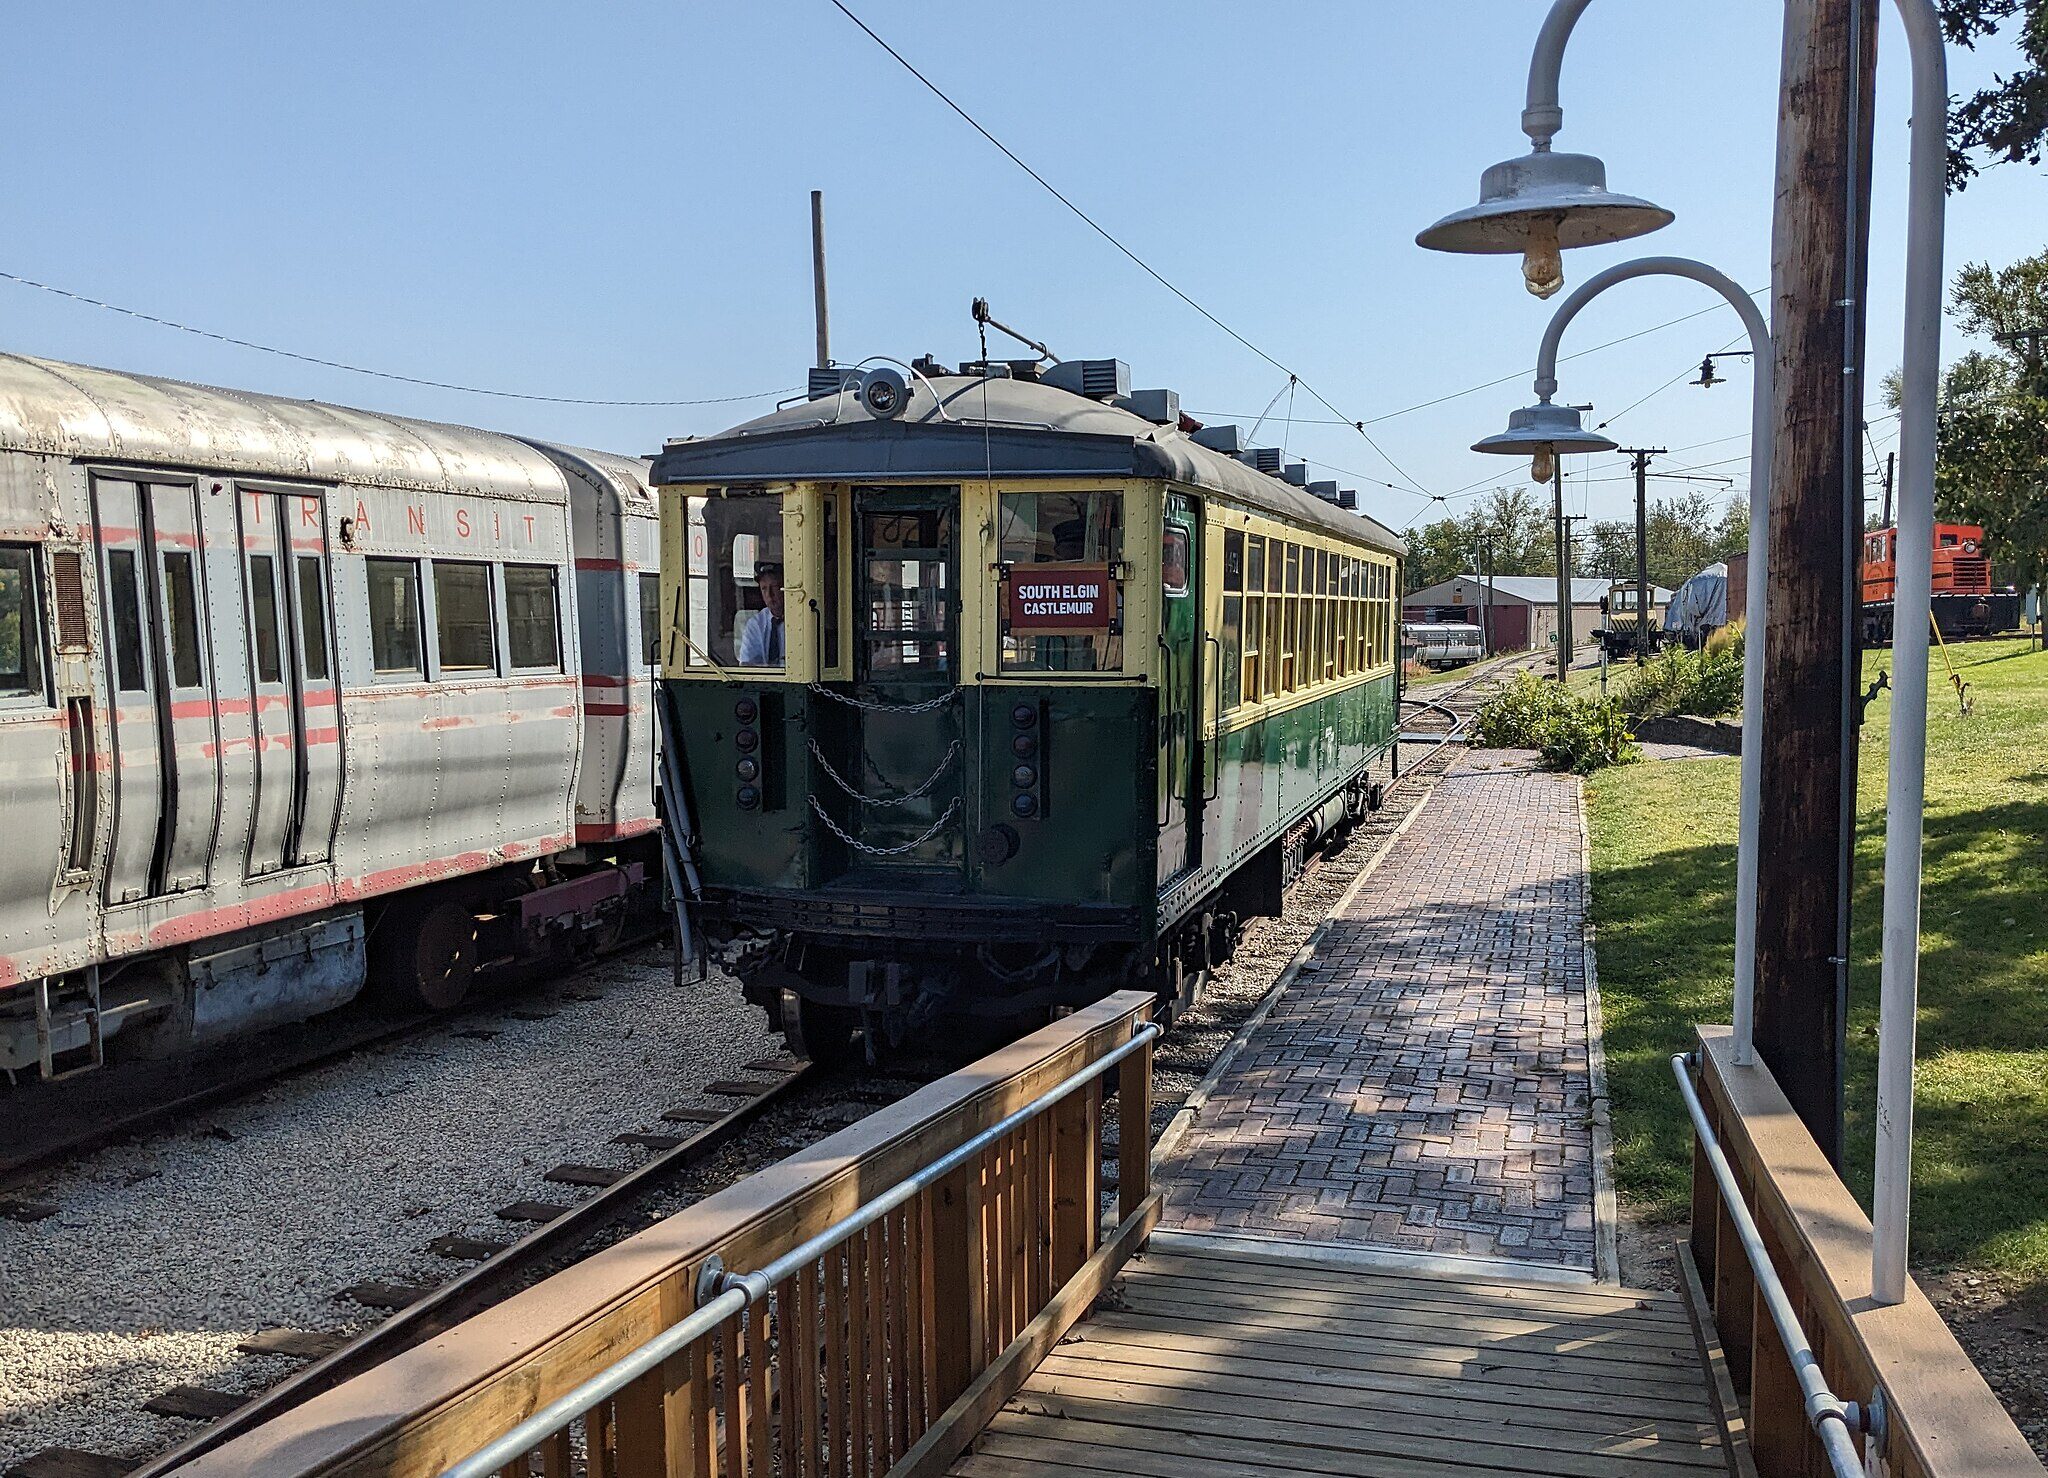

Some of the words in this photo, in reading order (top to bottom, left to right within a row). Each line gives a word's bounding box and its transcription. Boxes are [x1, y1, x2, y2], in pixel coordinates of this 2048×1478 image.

[247, 492, 535, 543] TRANSIT
[1018, 585, 1060, 600] SOUTH
[1062, 584, 1099, 599] ELGIN
[1023, 602, 1094, 615] CASTLEMUIR
